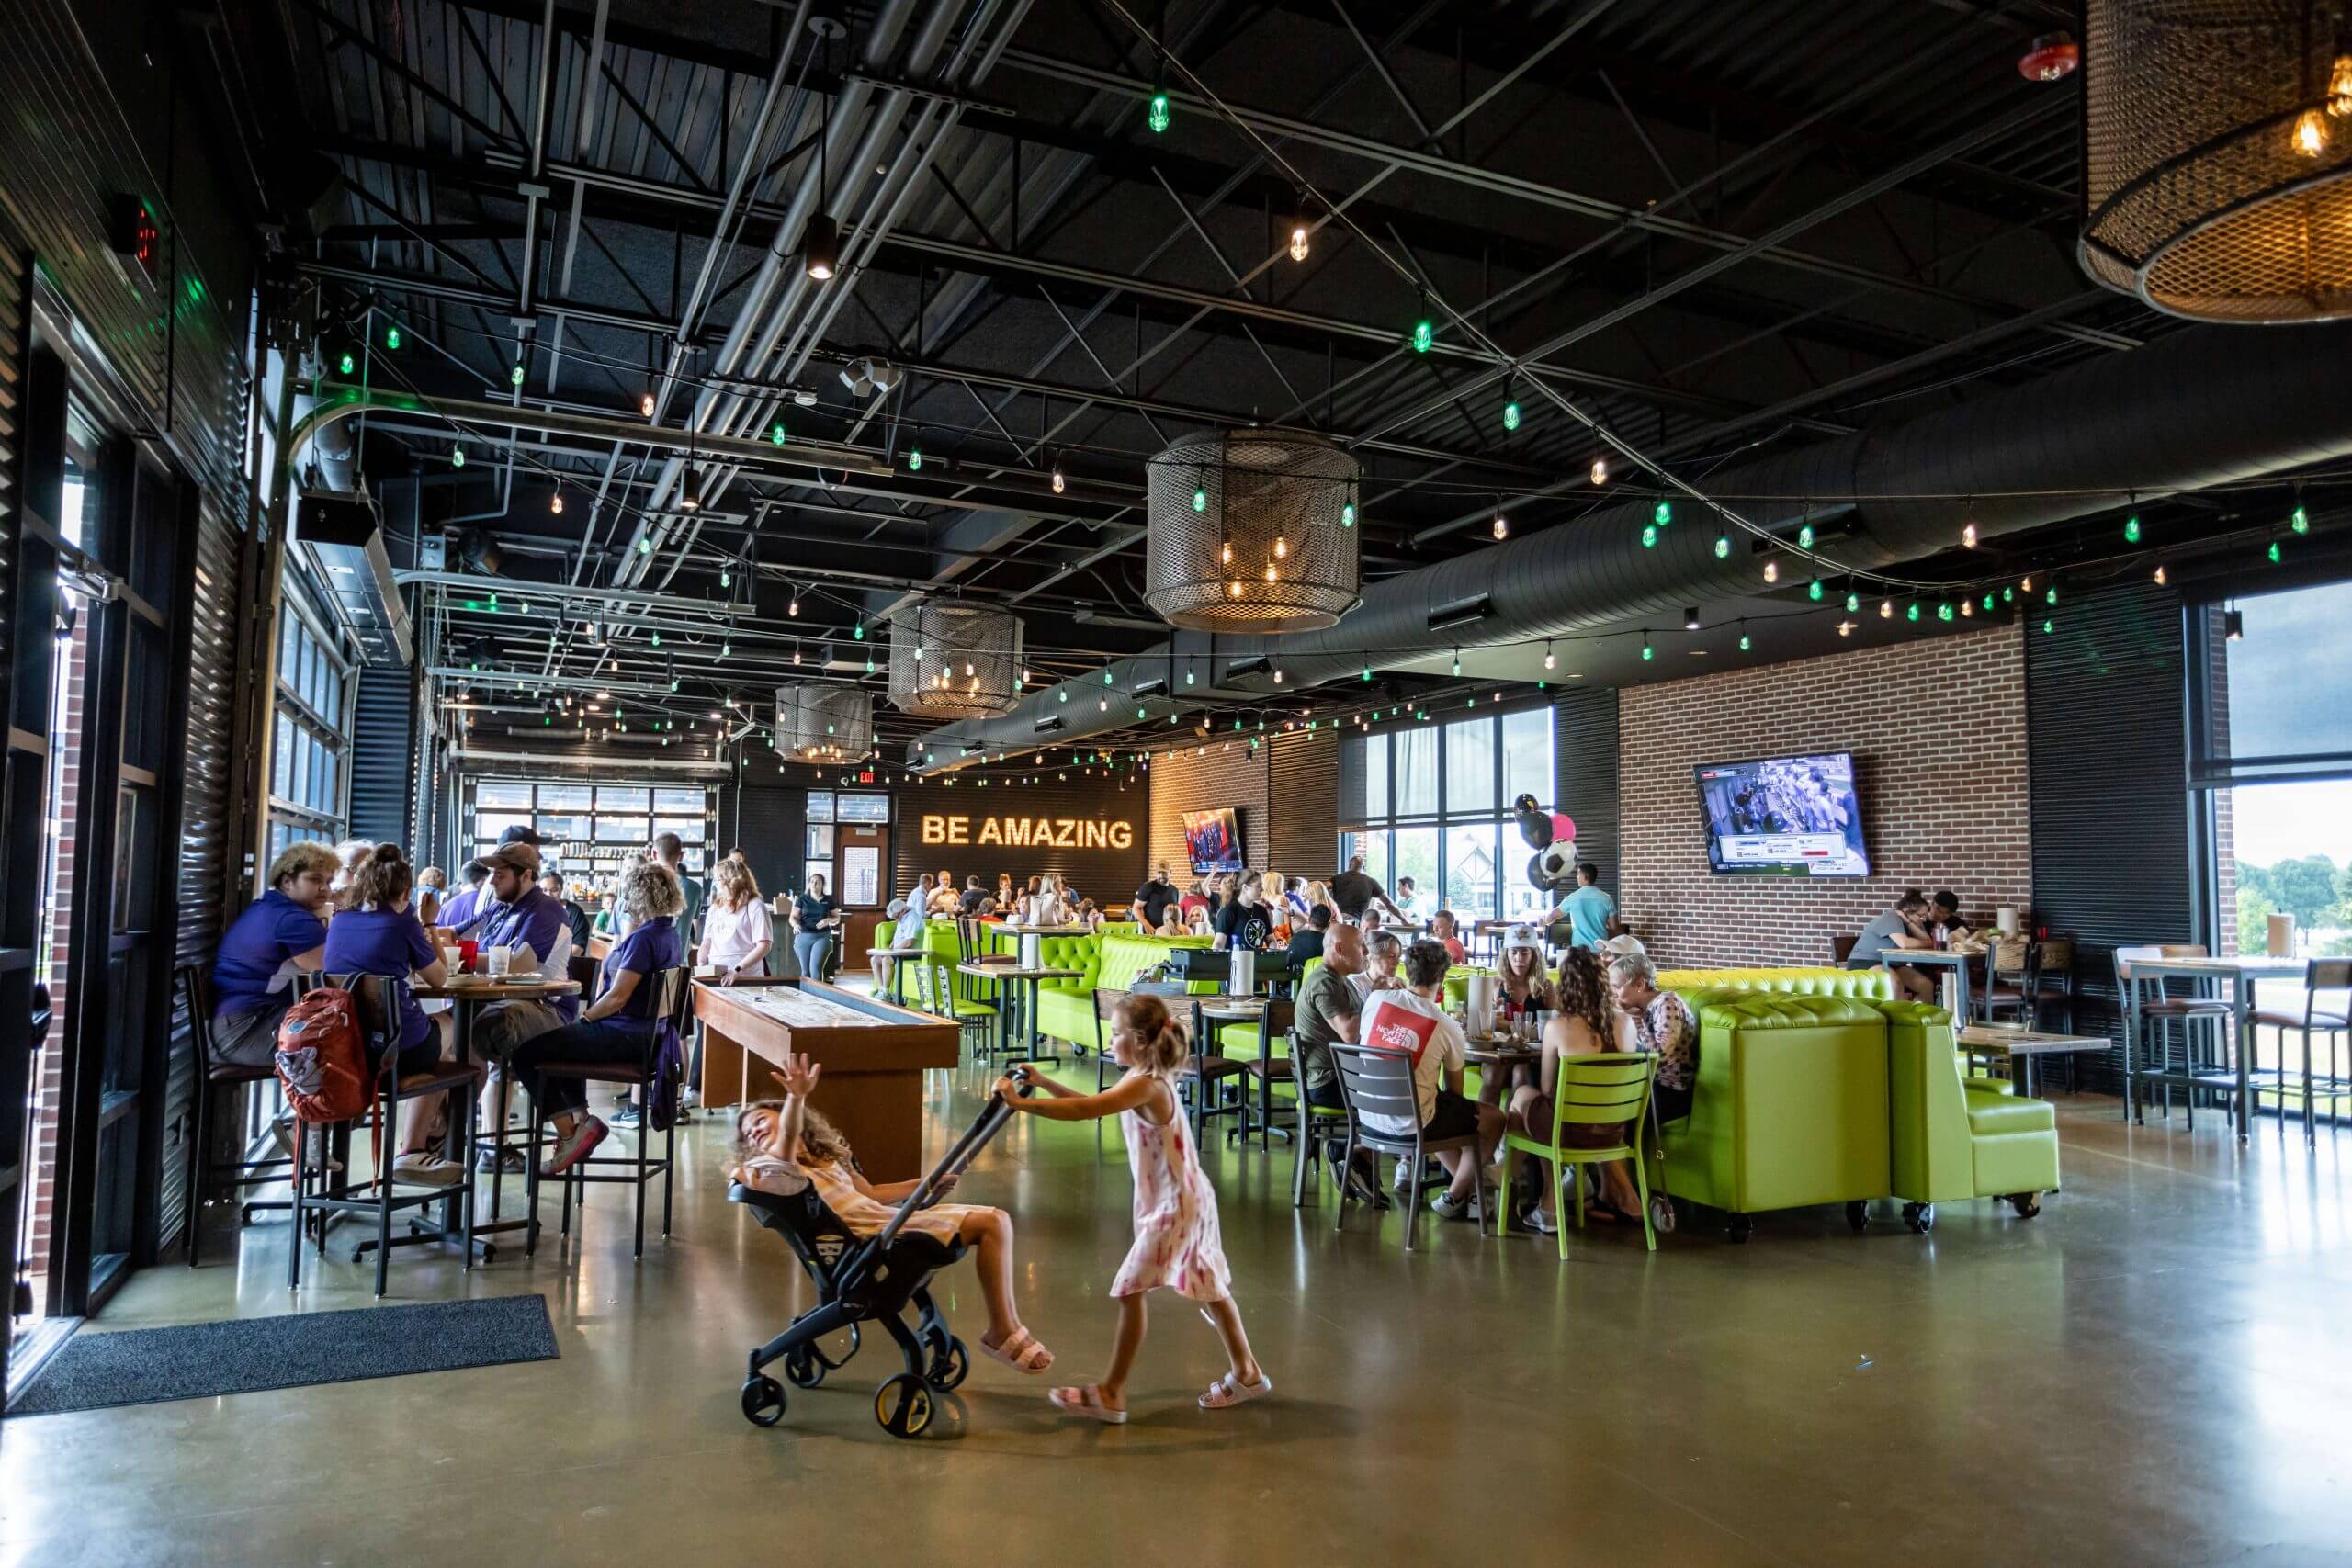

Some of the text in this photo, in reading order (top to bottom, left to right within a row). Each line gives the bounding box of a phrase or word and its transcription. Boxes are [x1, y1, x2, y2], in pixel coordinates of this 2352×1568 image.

[860, 772, 875, 784] EXIT
[922, 815, 1133, 849] BE AMAZING
[1376, 1024, 1406, 1040] NORTH
[1381, 1033, 1403, 1045] FACE
